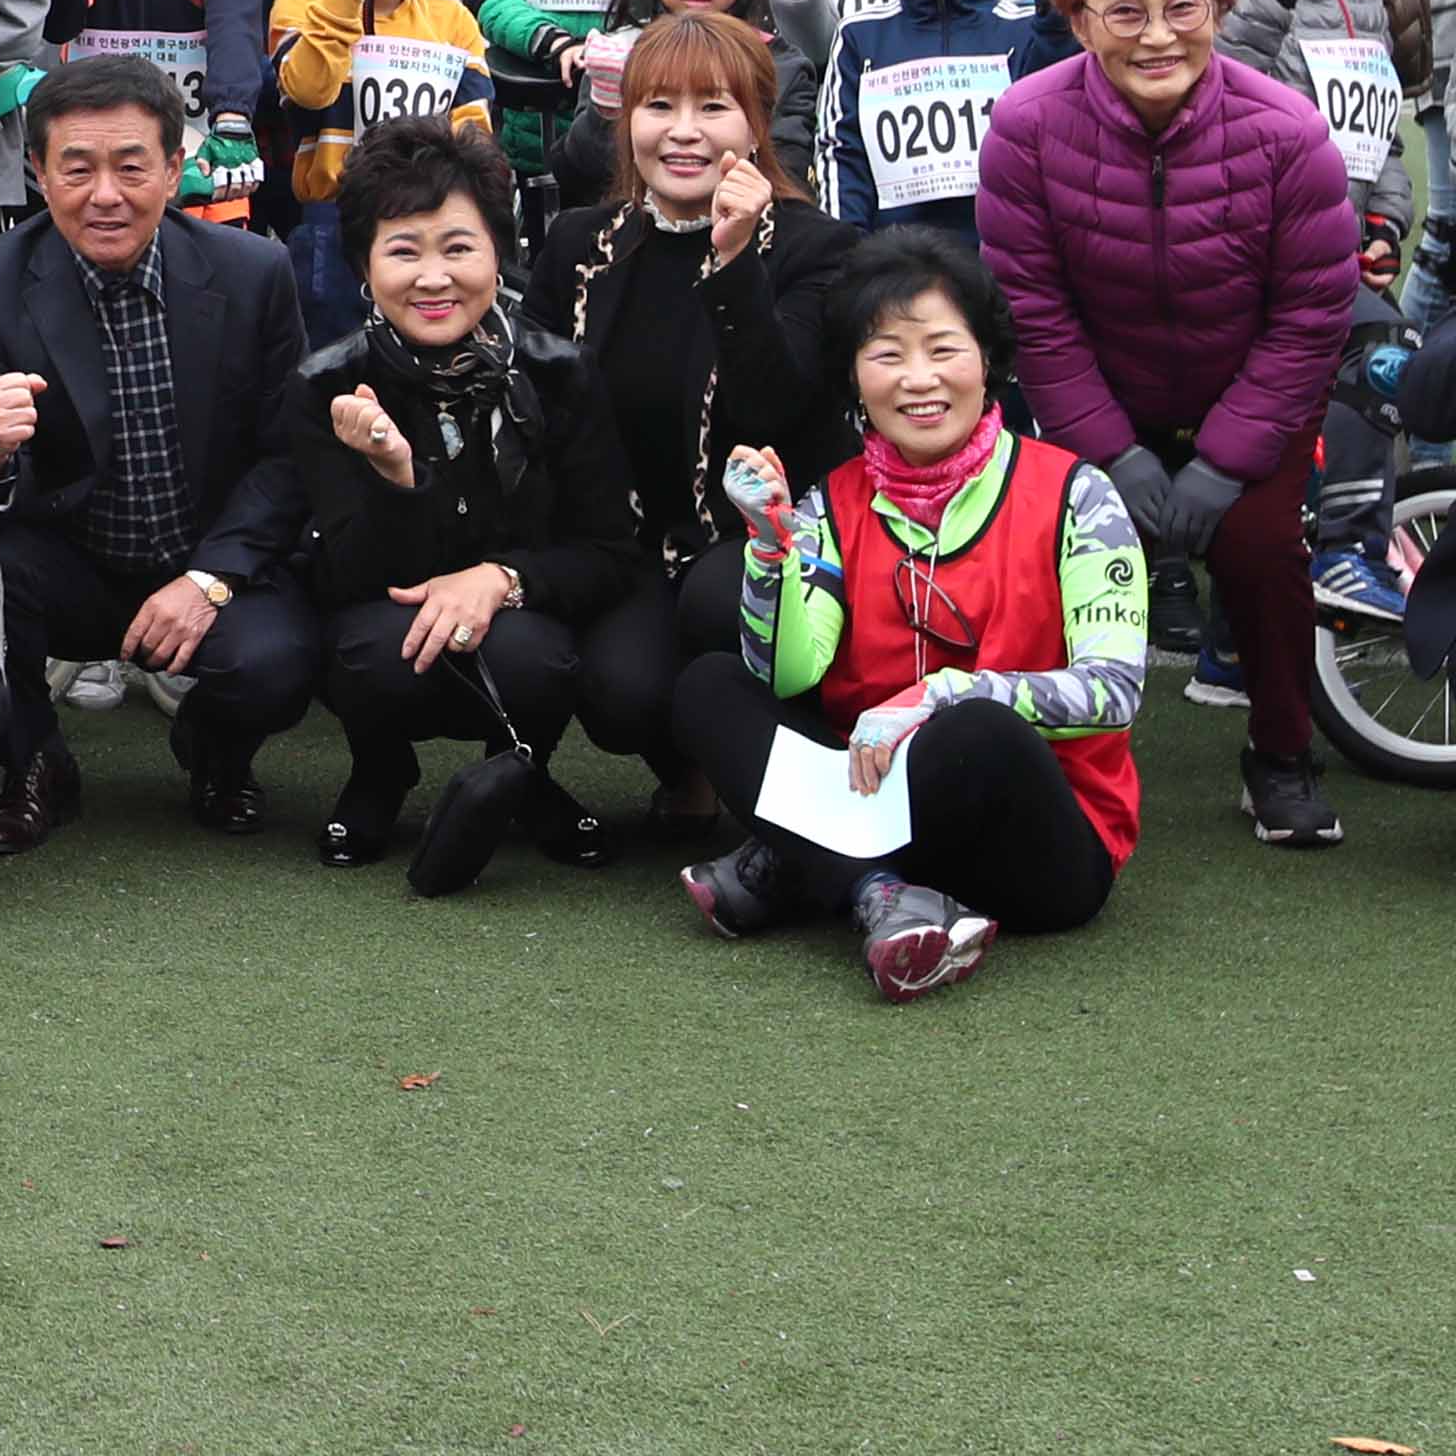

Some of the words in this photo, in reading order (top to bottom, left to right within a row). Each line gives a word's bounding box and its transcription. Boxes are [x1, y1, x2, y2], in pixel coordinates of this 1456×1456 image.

[98, 37, 153, 50] 인천광역시
[389, 45, 442, 61] 인천광역시
[445, 53, 467, 66] 동구
[388, 58, 442, 76] 외발자전거
[892, 65, 943, 83] 인천광역시
[893, 80, 945, 97] 외발자전거
[949, 78, 971, 90] 대회
[1327, 77, 1399, 143] 02012
